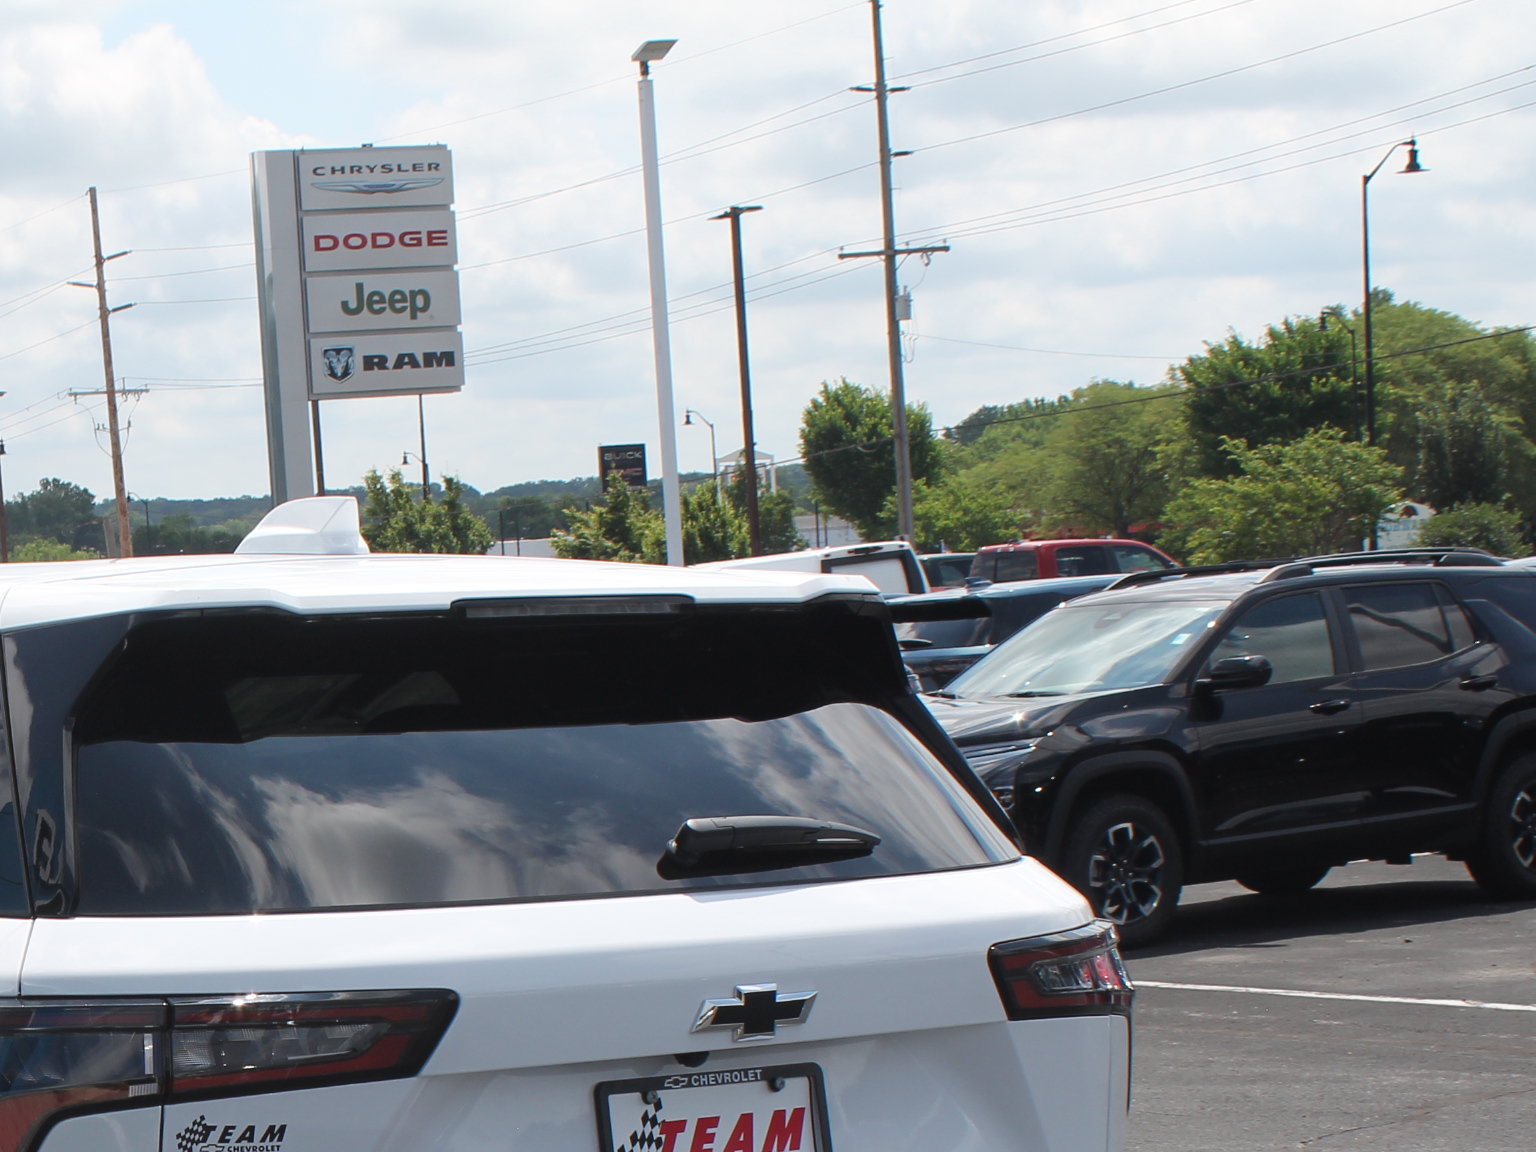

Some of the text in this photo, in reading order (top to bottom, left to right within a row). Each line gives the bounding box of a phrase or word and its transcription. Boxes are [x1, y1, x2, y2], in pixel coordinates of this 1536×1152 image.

[312, 162, 440, 176] CHRYSLER
[313, 230, 448, 251] DODGE
[341, 282, 431, 320] Jeep
[362, 351, 455, 372] RAM
[604, 451, 643, 460] BUICK
[691, 1069, 762, 1087] CHEVROLET
[200, 1124, 287, 1143] TEAM
[227, 1145, 281, 1152] CHEVROLET
